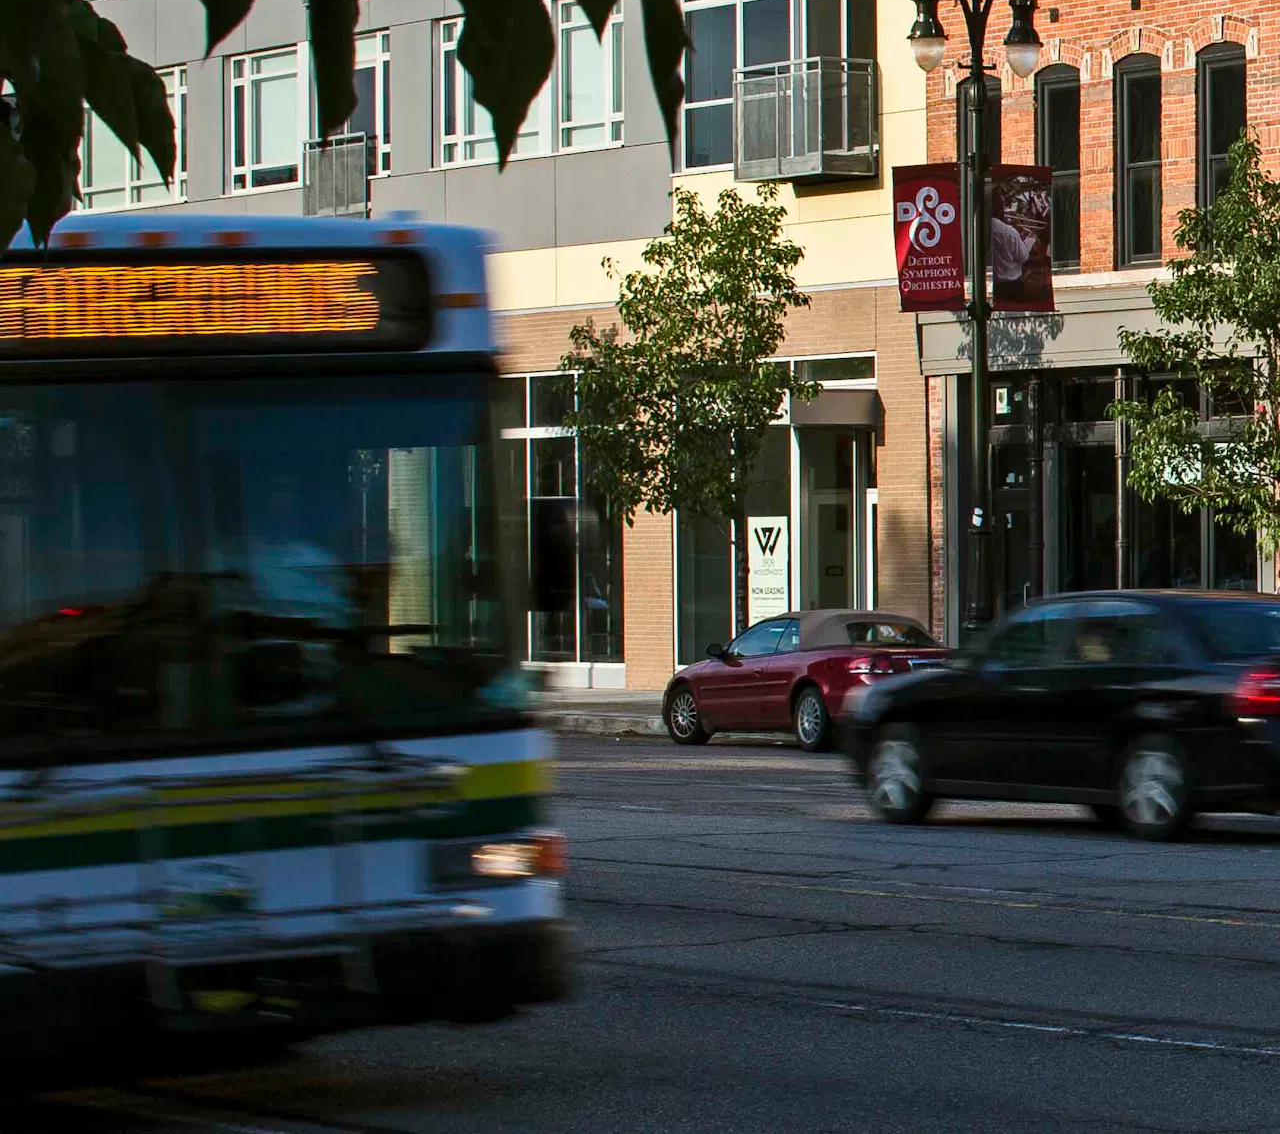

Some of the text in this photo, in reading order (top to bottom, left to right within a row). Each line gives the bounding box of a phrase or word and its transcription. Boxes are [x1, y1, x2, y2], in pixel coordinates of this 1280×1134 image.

[908, 255, 952, 266] DETROIT
[902, 267, 958, 279] SYMPHONY
[901, 280, 961, 292] ORCHESTRA
